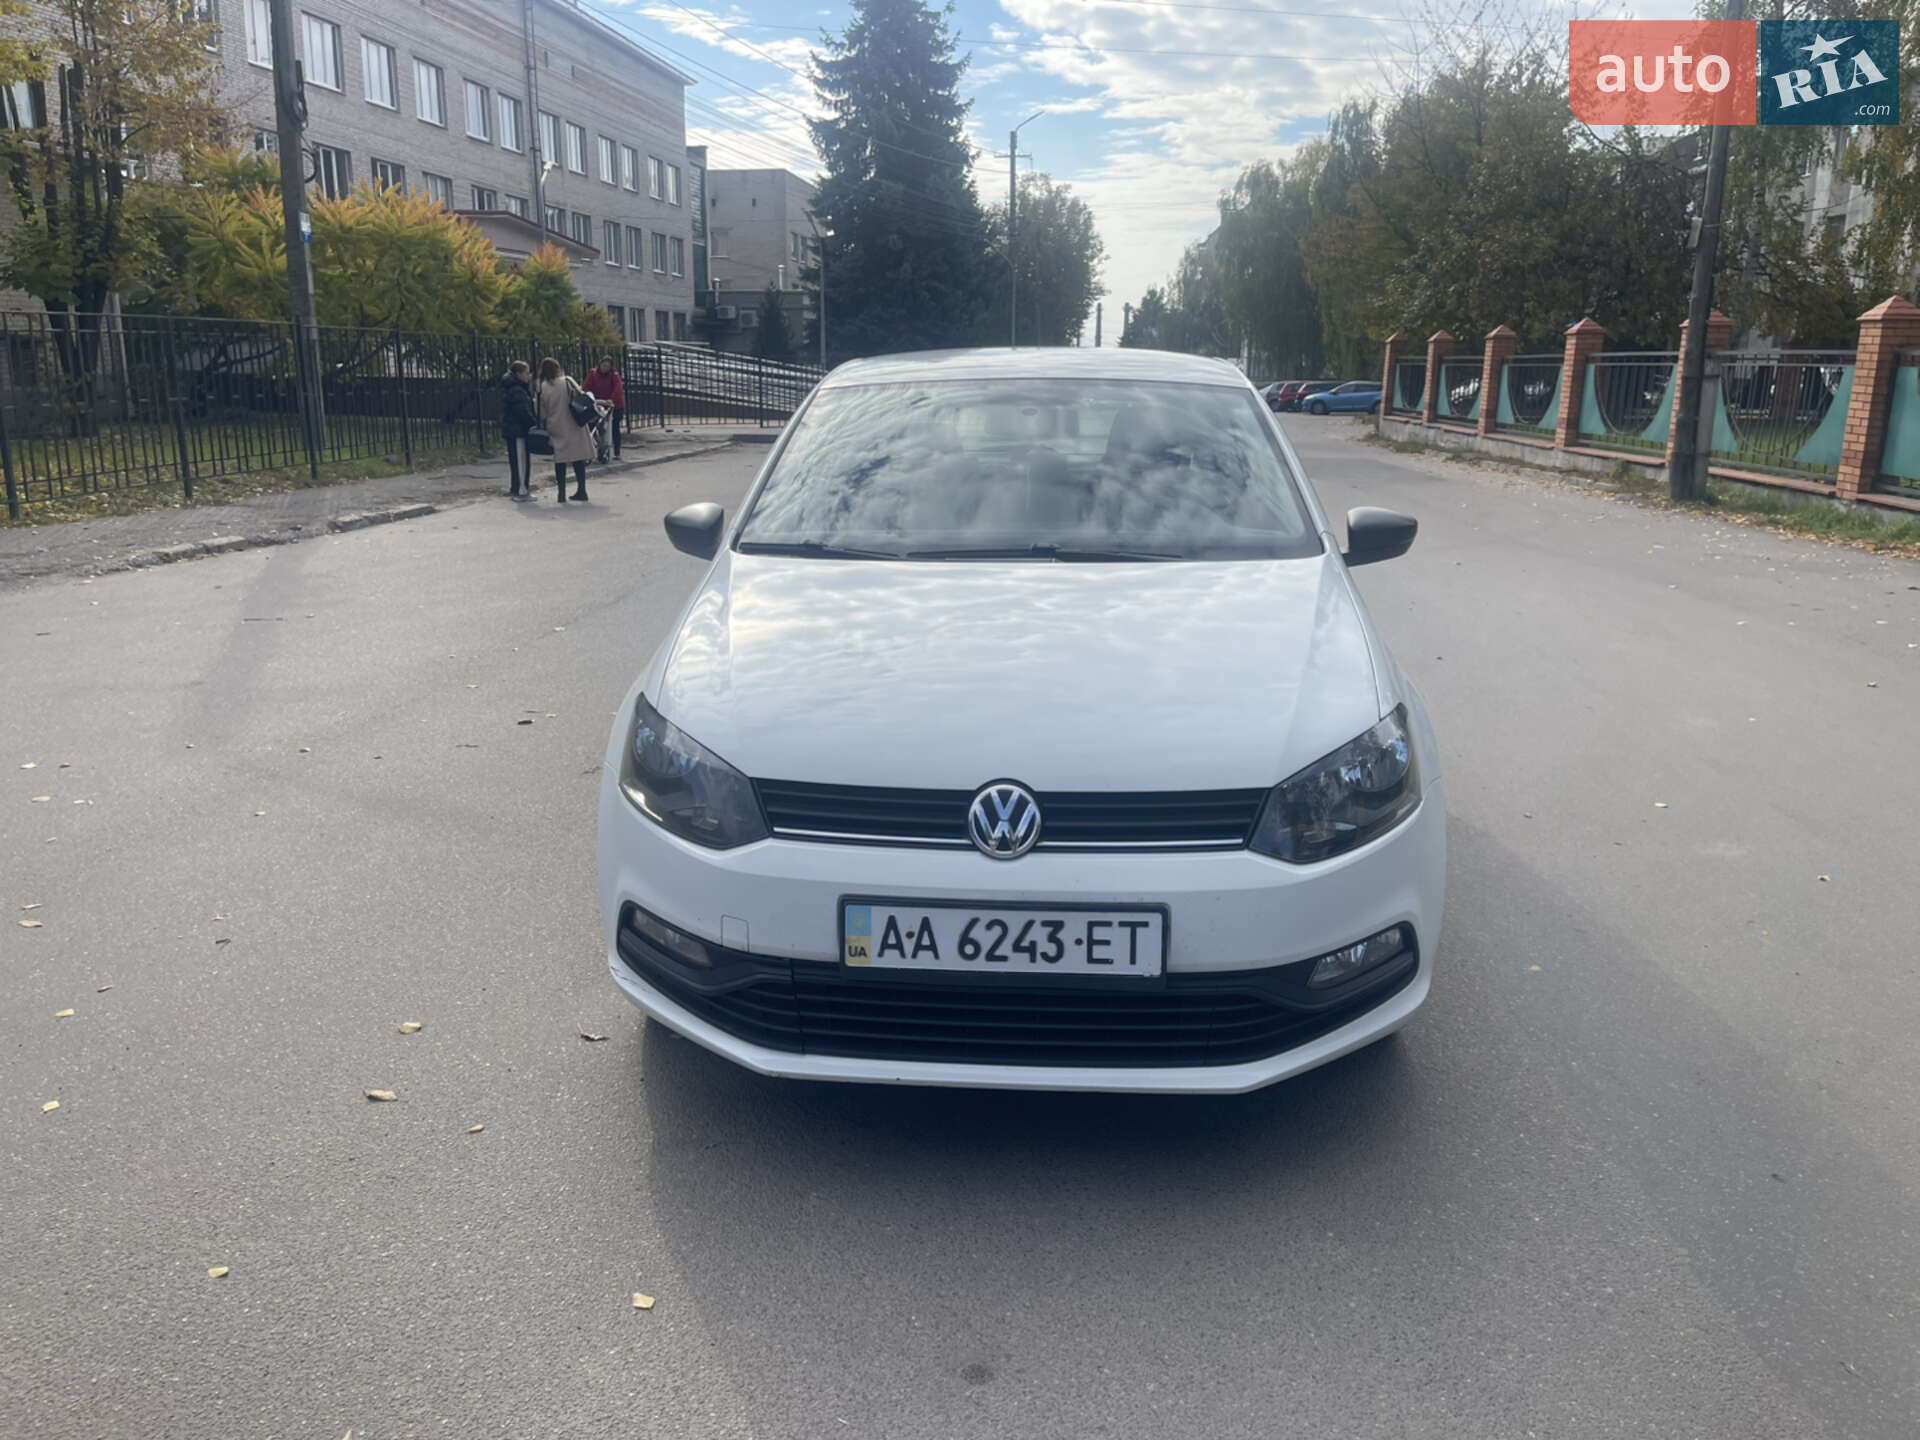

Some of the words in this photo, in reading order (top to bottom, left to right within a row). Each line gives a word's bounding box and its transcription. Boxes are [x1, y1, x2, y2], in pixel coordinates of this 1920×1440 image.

[848, 945, 867, 958] UA
[957, 917, 1065, 964] 6243
[1086, 920, 1149, 965] ET
